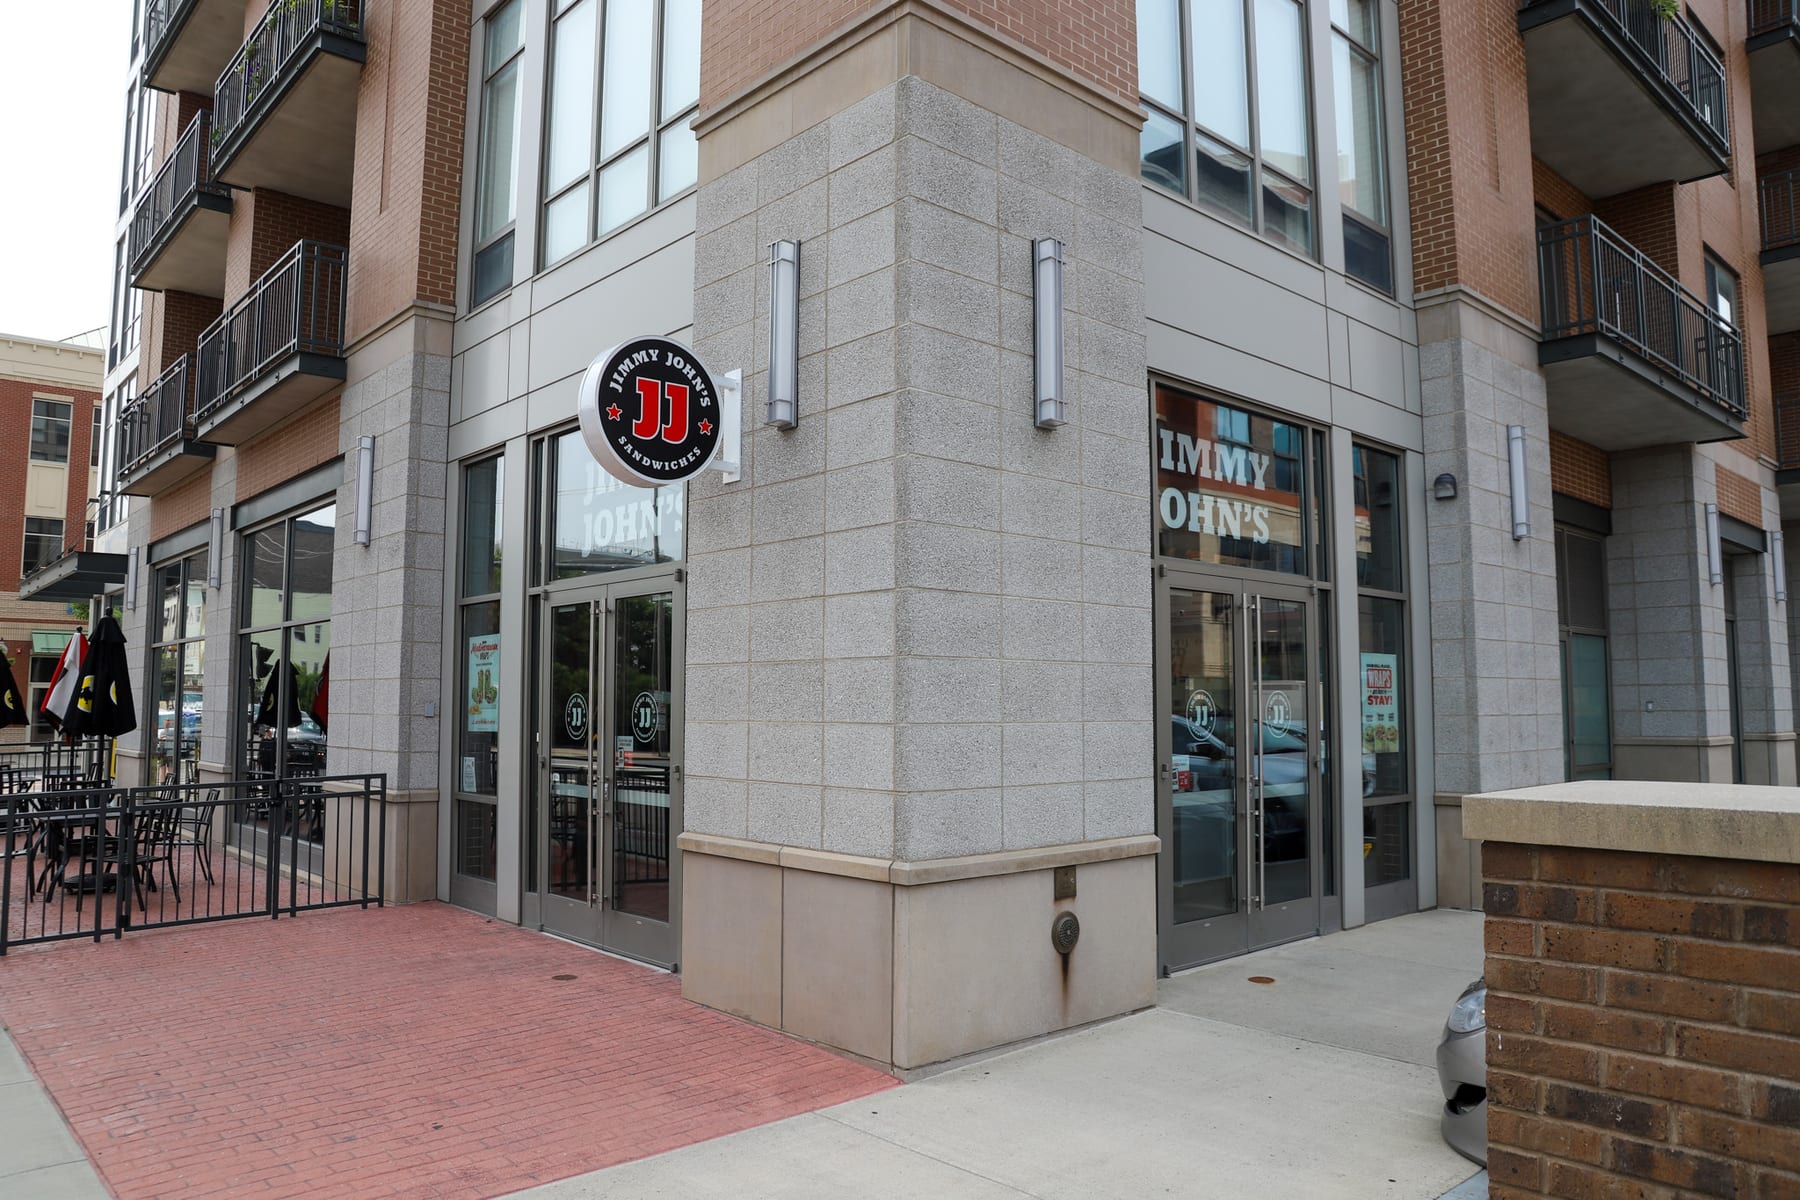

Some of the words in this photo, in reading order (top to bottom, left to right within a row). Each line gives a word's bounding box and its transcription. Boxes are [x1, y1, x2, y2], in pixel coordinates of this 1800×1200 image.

[609, 348, 659, 393] JIMMY
[665, 352, 711, 408] JOHN'S
[632, 376, 690, 445] JJ
[618, 435, 702, 471] SANDWICHES
[1159, 428, 1270, 491] IMMY
[1159, 487, 1270, 545] OHN'S
[1367, 695, 1393, 706] STAY!
[1368, 670, 1392, 688] WRAPS
